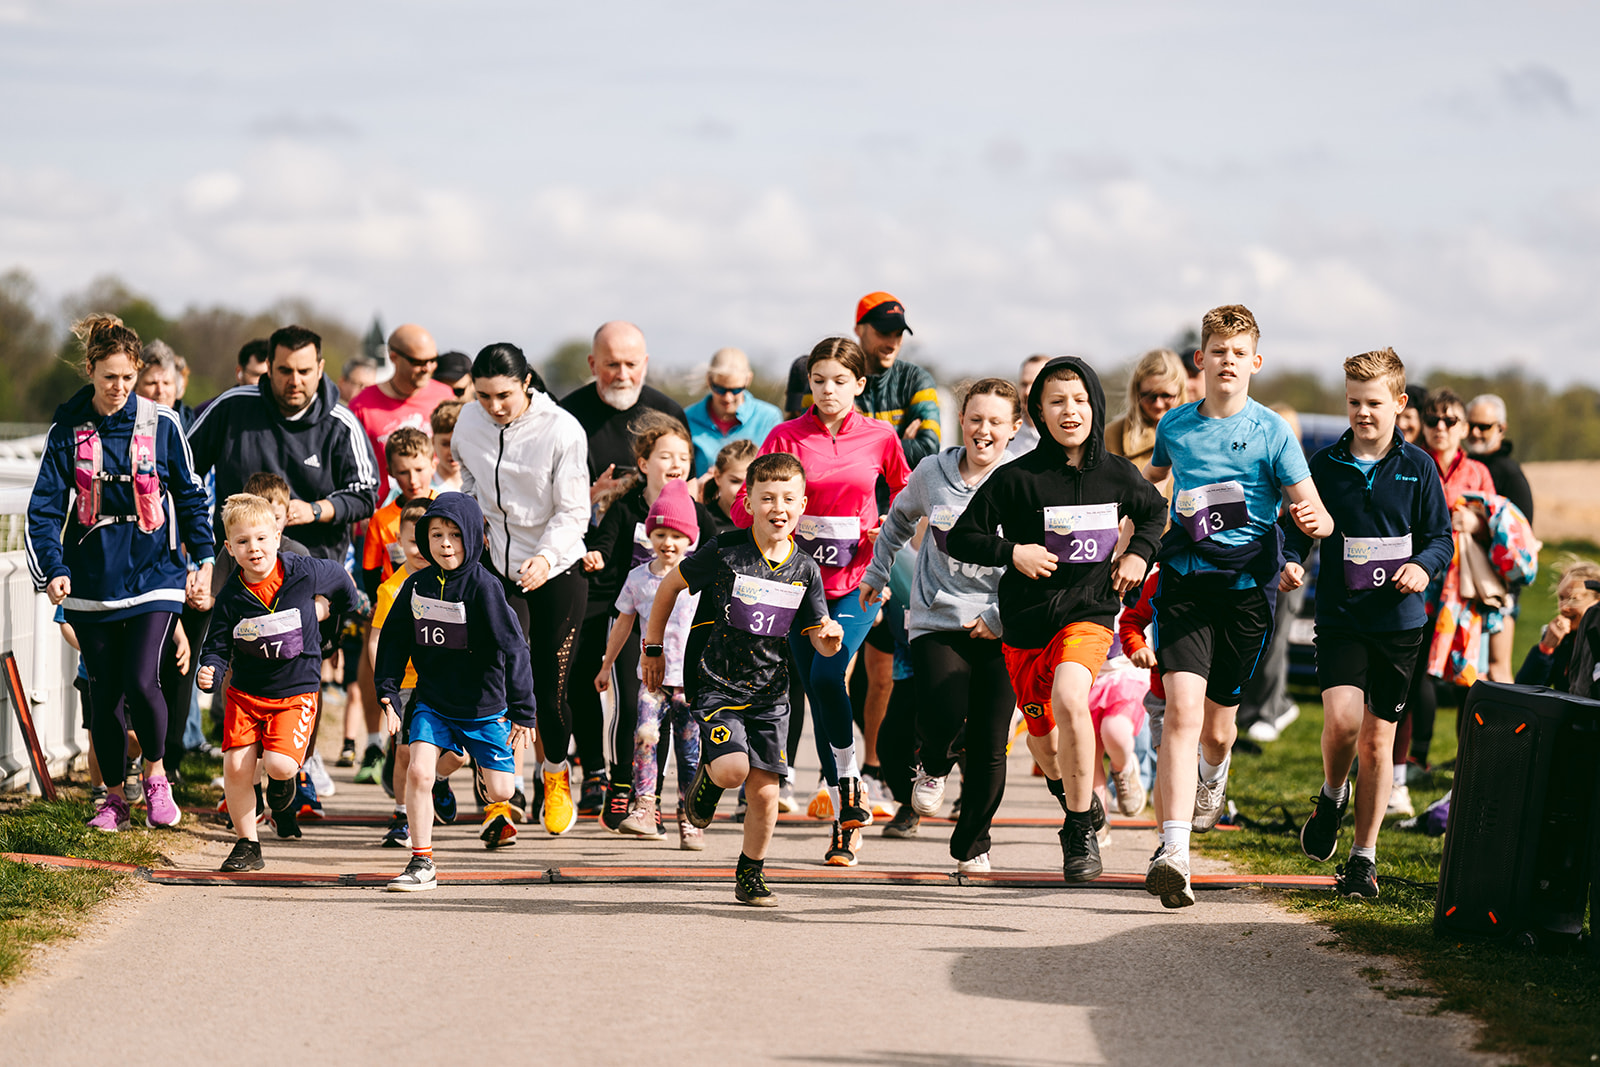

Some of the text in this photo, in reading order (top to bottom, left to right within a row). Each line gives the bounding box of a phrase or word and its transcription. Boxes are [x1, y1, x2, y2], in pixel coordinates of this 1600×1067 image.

[1049, 517, 1070, 525] TEWV
[1198, 511, 1224, 535] 13
[812, 544, 839, 565] 42
[1069, 538, 1098, 560] 29
[1372, 567, 1386, 587] 9
[737, 584, 758, 595] TEWV
[749, 610, 776, 634] 31
[420, 625, 446, 645] 16
[259, 640, 284, 659] 17
